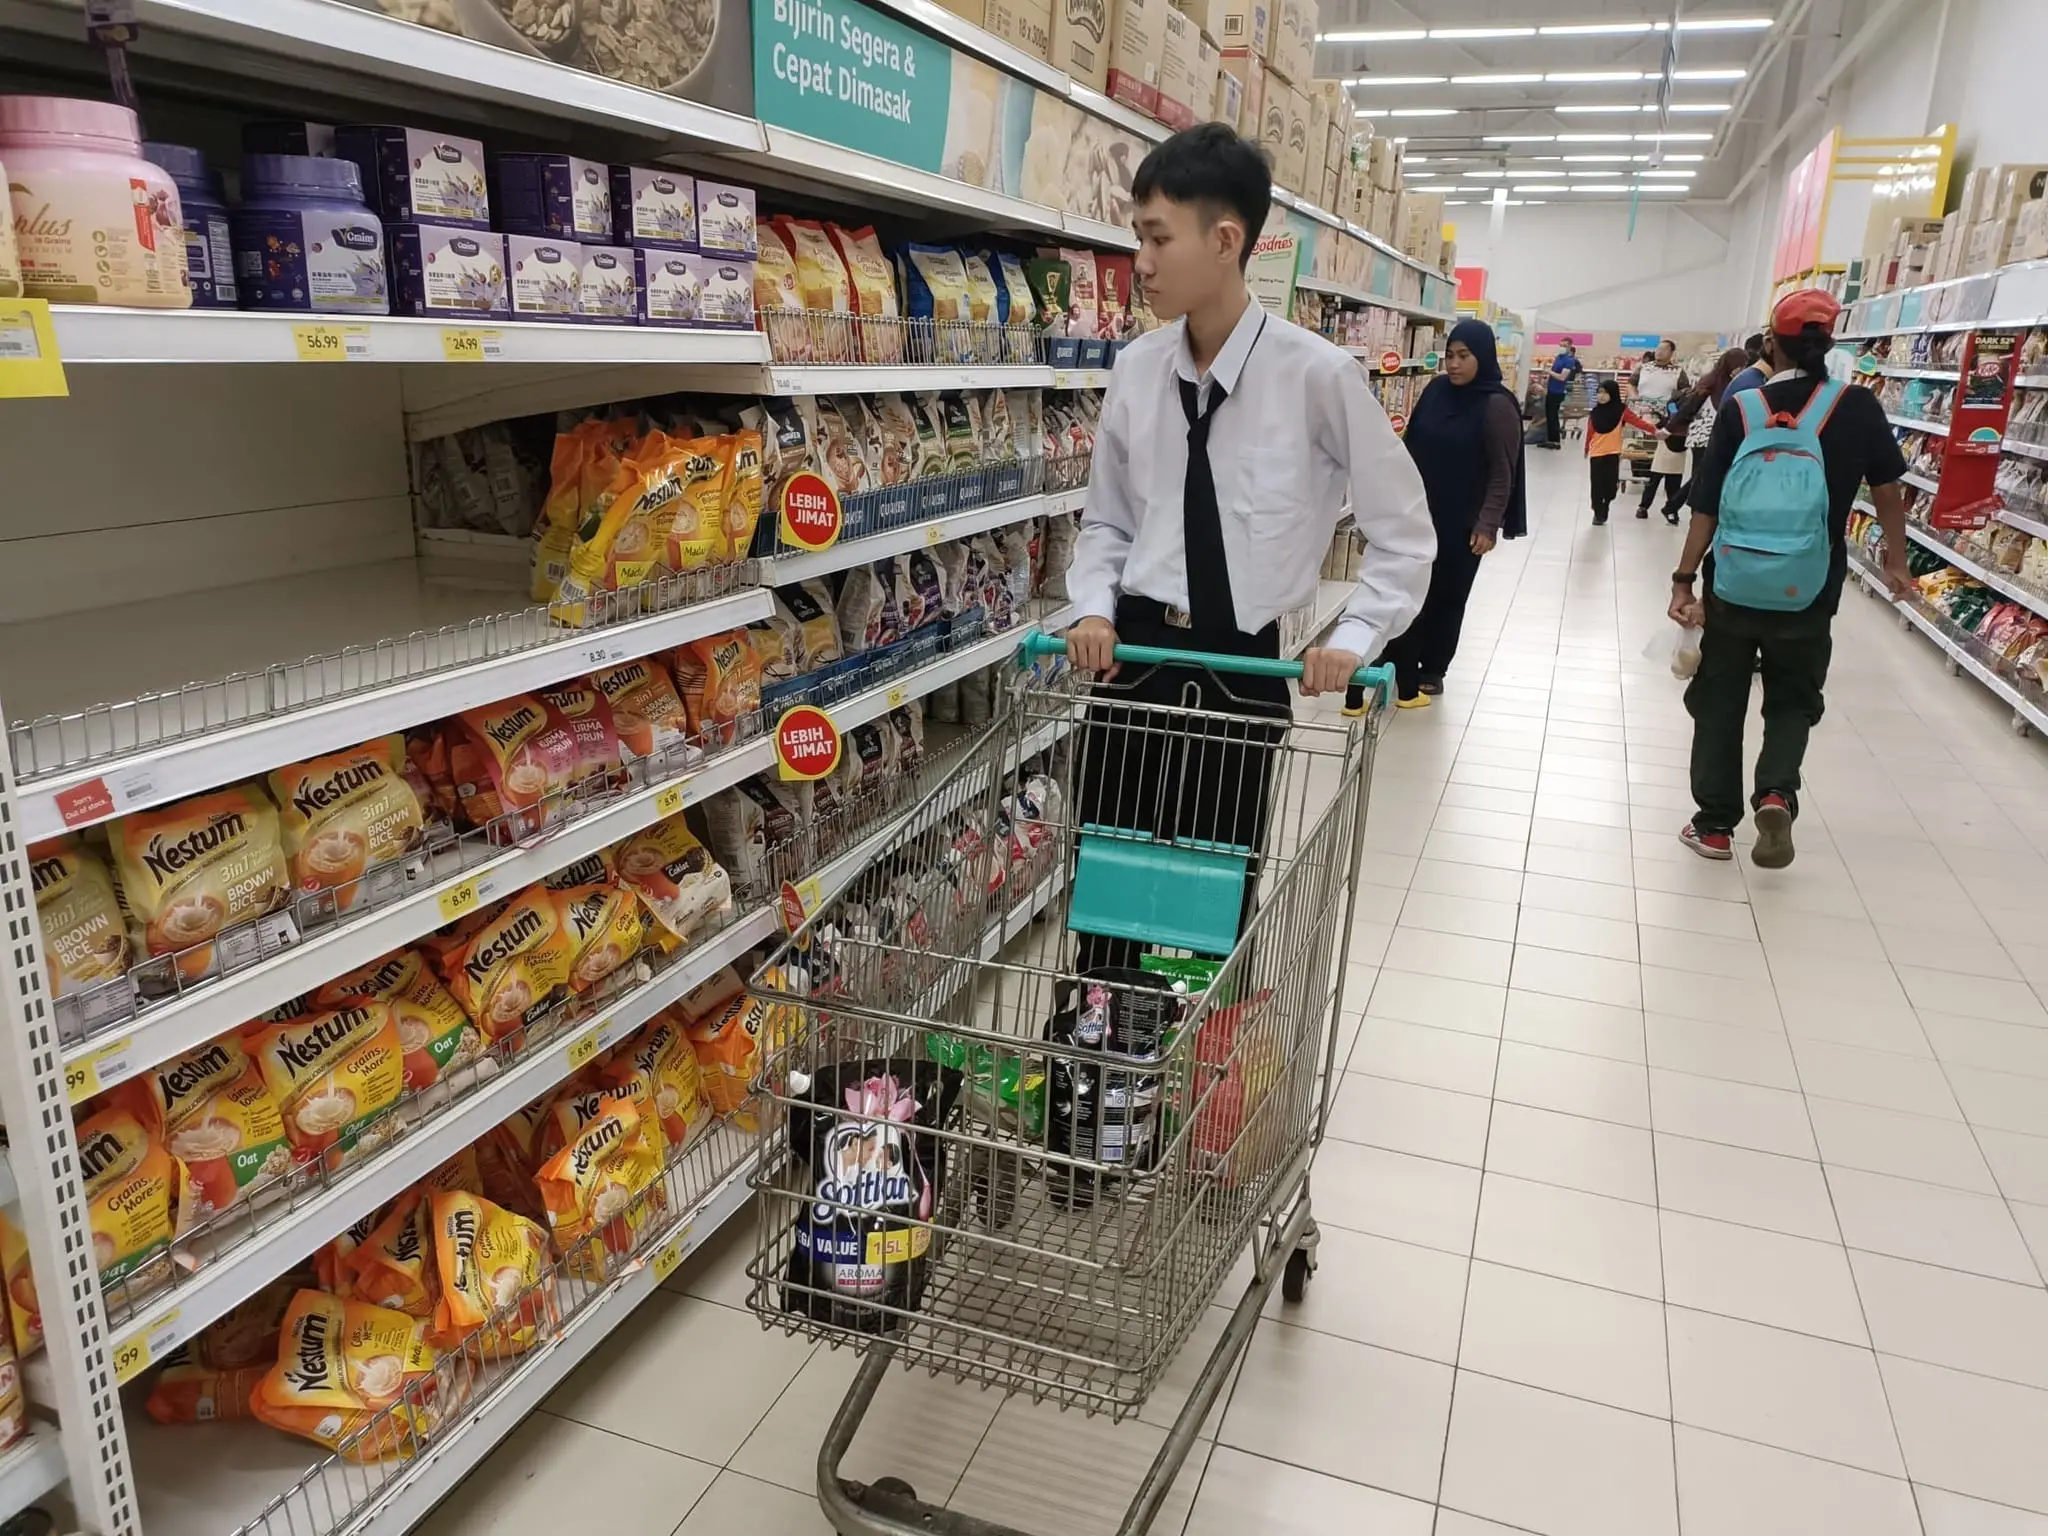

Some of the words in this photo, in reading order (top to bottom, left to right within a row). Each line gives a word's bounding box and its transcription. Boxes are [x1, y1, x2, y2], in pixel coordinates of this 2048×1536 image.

[774, 0, 834, 43] Bijirin
[840, 15, 900, 71] Segera
[904, 45, 916, 78] &
[773, 42, 833, 96] Cepat
[838, 66, 911, 124] Dimasak
[307, 335, 338, 349] 56.99
[453, 337, 478, 350] 24.99
[789, 492, 827, 510] LEBIH
[795, 509, 834, 527] JIMAT
[590, 649, 606, 663] 8.30
[602, 662, 645, 697] estum
[487, 706, 536, 750] Nestum
[573, 720, 604, 733] URMA
[783, 727, 824, 746] LEBIH
[791, 741, 833, 760] JIMAT
[293, 759, 383, 820] Nestum
[360, 796, 391, 821] 3in1
[367, 807, 410, 838] BROWN
[142, 813, 246, 886] Nestum
[369, 829, 394, 850] RICE
[220, 854, 250, 884] 3in1
[227, 867, 274, 902] BROWN
[229, 891, 258, 915] RICE
[451, 888, 472, 907] 8.99
[53, 912, 109, 954] BROWN
[60, 941, 94, 967] RICE
[465, 909, 542, 984] Nestum
[276, 1005, 370, 1079] Nestum
[434, 1037, 454, 1054] Oat
[346, 1045, 381, 1074] Grains
[361, 1057, 386, 1077] More
[65, 1069, 87, 1090] 99
[237, 1152, 258, 1169] Oat
[107, 1176, 148, 1212] Grains
[123, 1186, 153, 1216] More
[816, 1237, 858, 1257] VALUE
[839, 1268, 884, 1279] AROMA
[284, 1312, 334, 1393] Nestum
